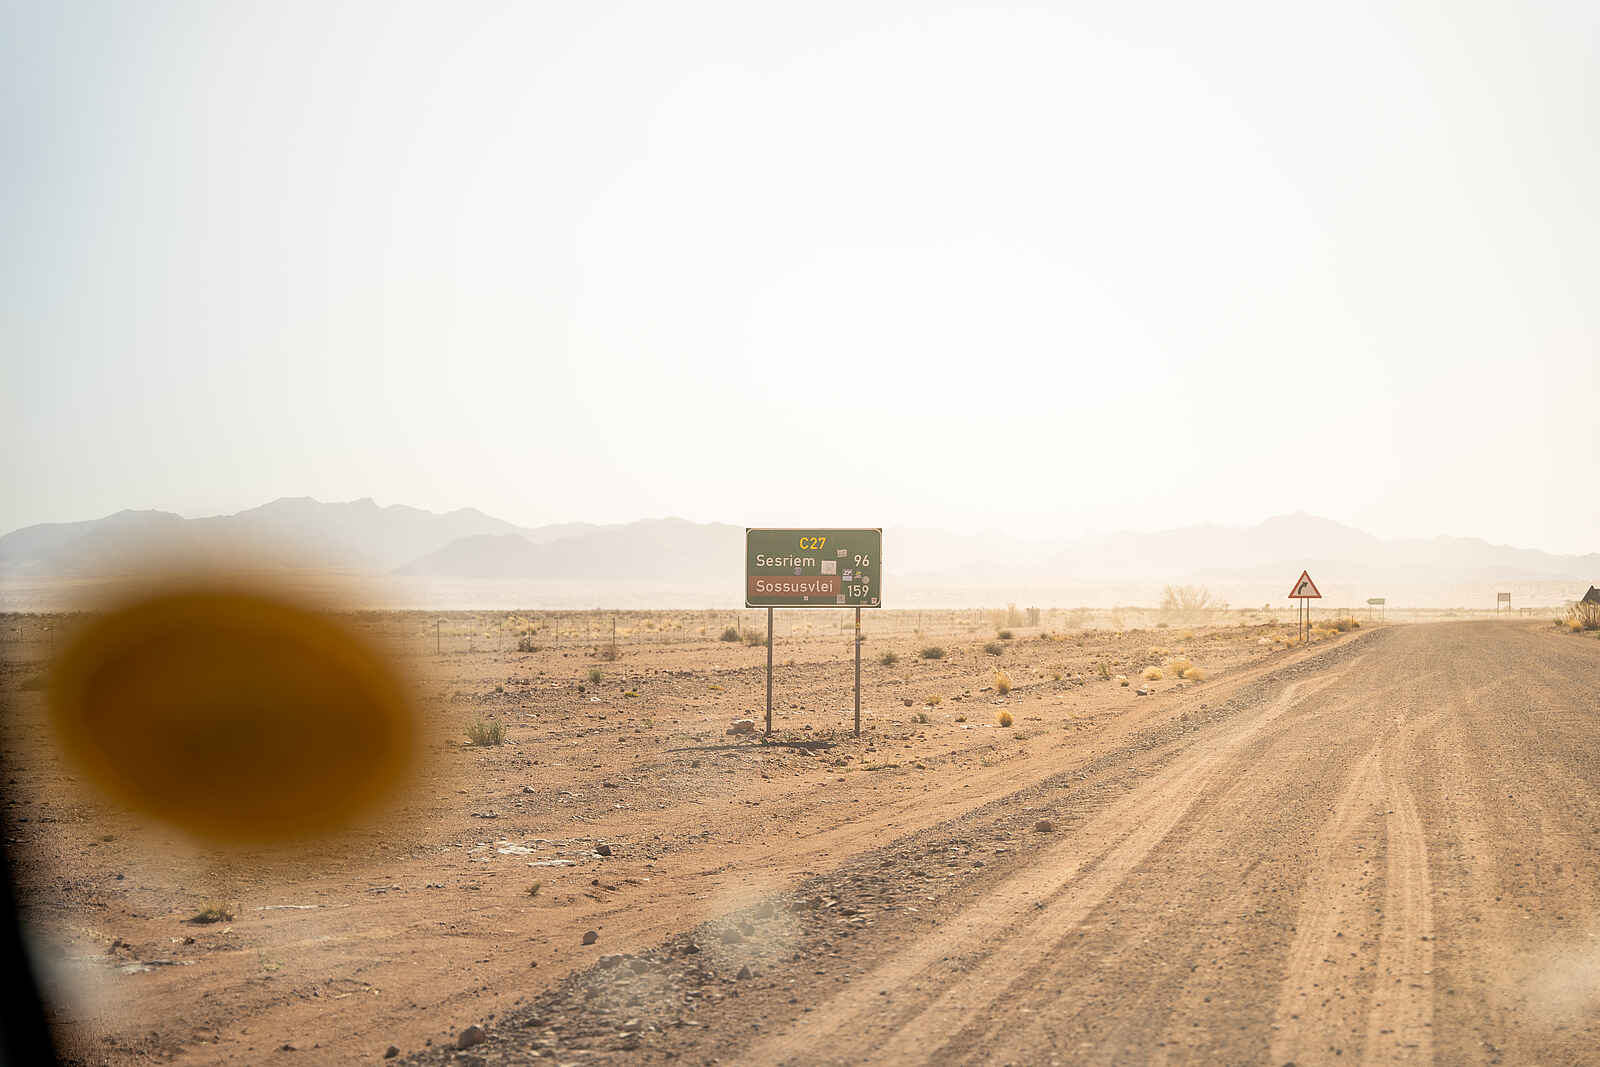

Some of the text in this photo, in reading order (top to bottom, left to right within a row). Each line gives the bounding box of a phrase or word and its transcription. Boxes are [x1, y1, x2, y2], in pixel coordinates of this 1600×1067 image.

[799, 537, 827, 550] C27
[756, 554, 870, 567] Sesriem 96
[756, 580, 869, 597] Sossusvlei 159
